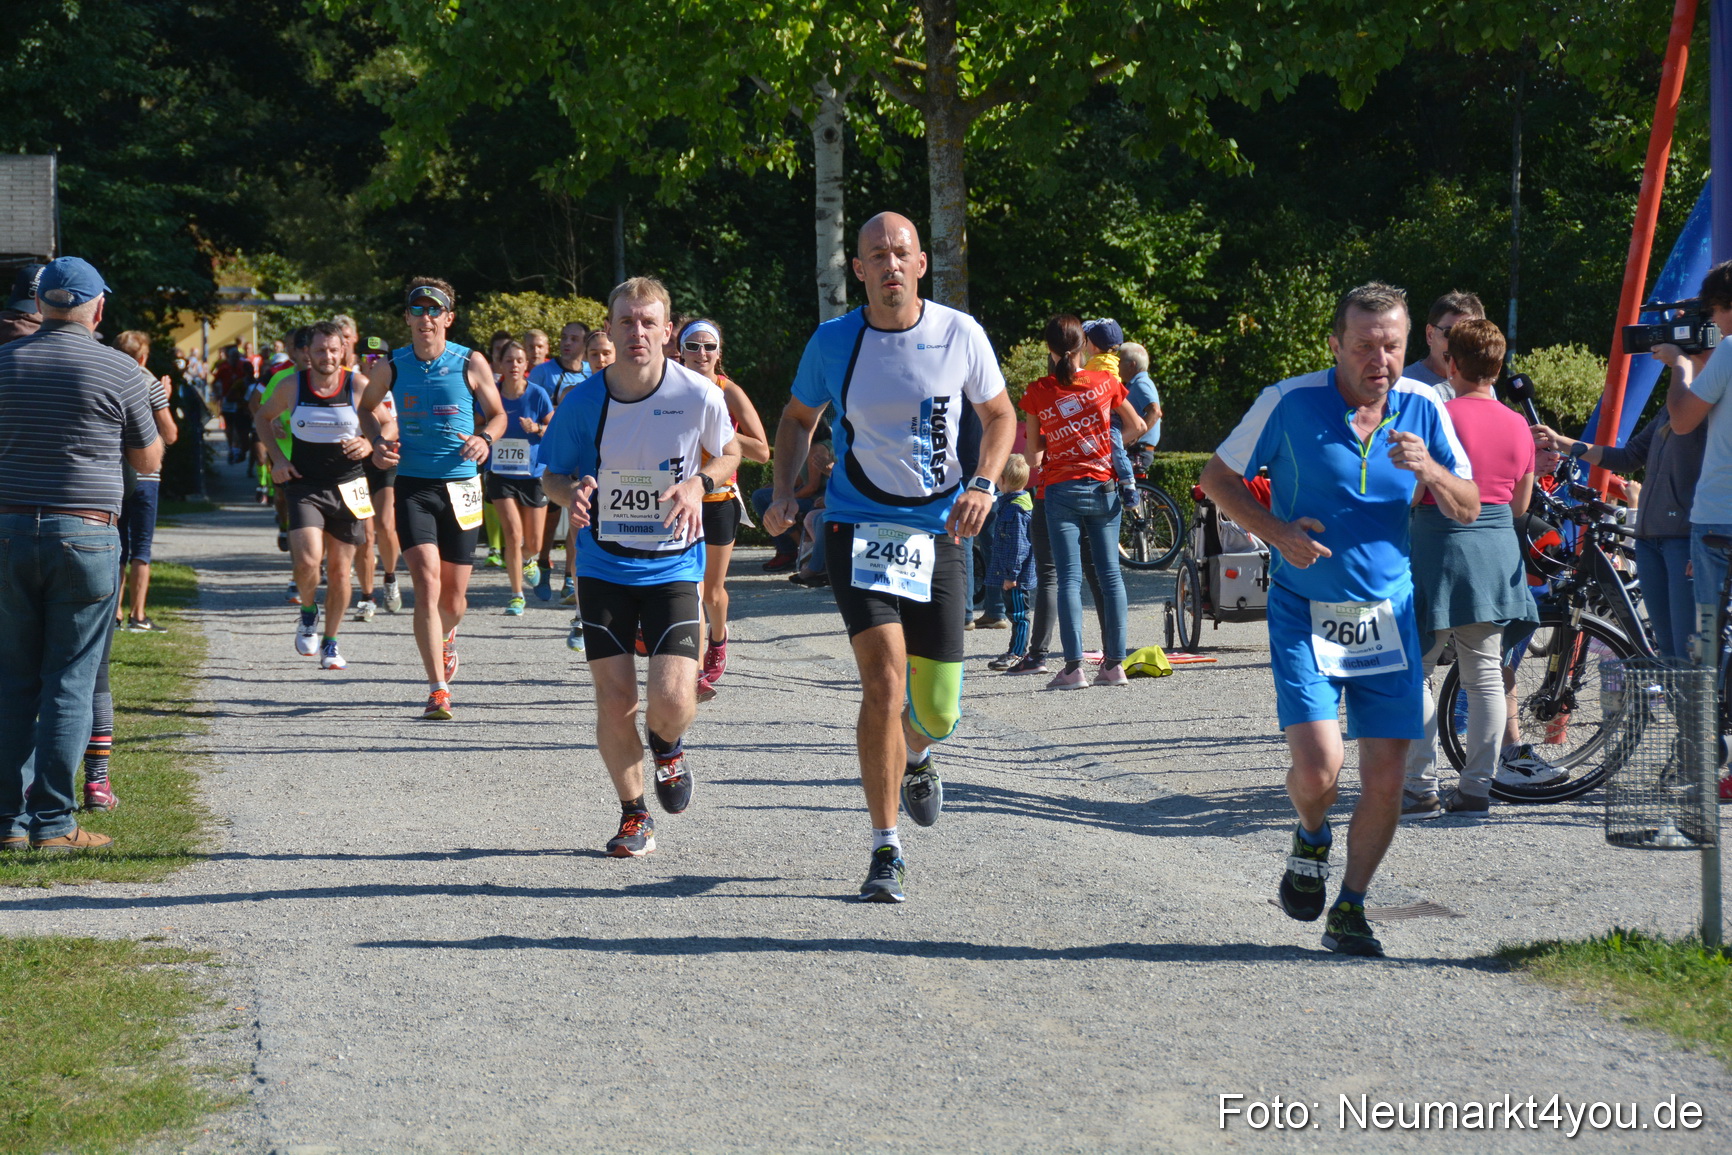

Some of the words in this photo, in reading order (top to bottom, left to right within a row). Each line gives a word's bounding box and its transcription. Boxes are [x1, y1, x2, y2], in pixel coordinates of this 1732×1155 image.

[930, 396, 950, 487] HUBER
[497, 448, 524, 460] 2176
[620, 475, 652, 485] BOCK
[610, 488, 660, 510] 2491
[618, 523, 654, 533] Thomas
[865, 541, 922, 570] 2494
[1322, 616, 1380, 646] 2601
[1340, 656, 1380, 669] Michael
